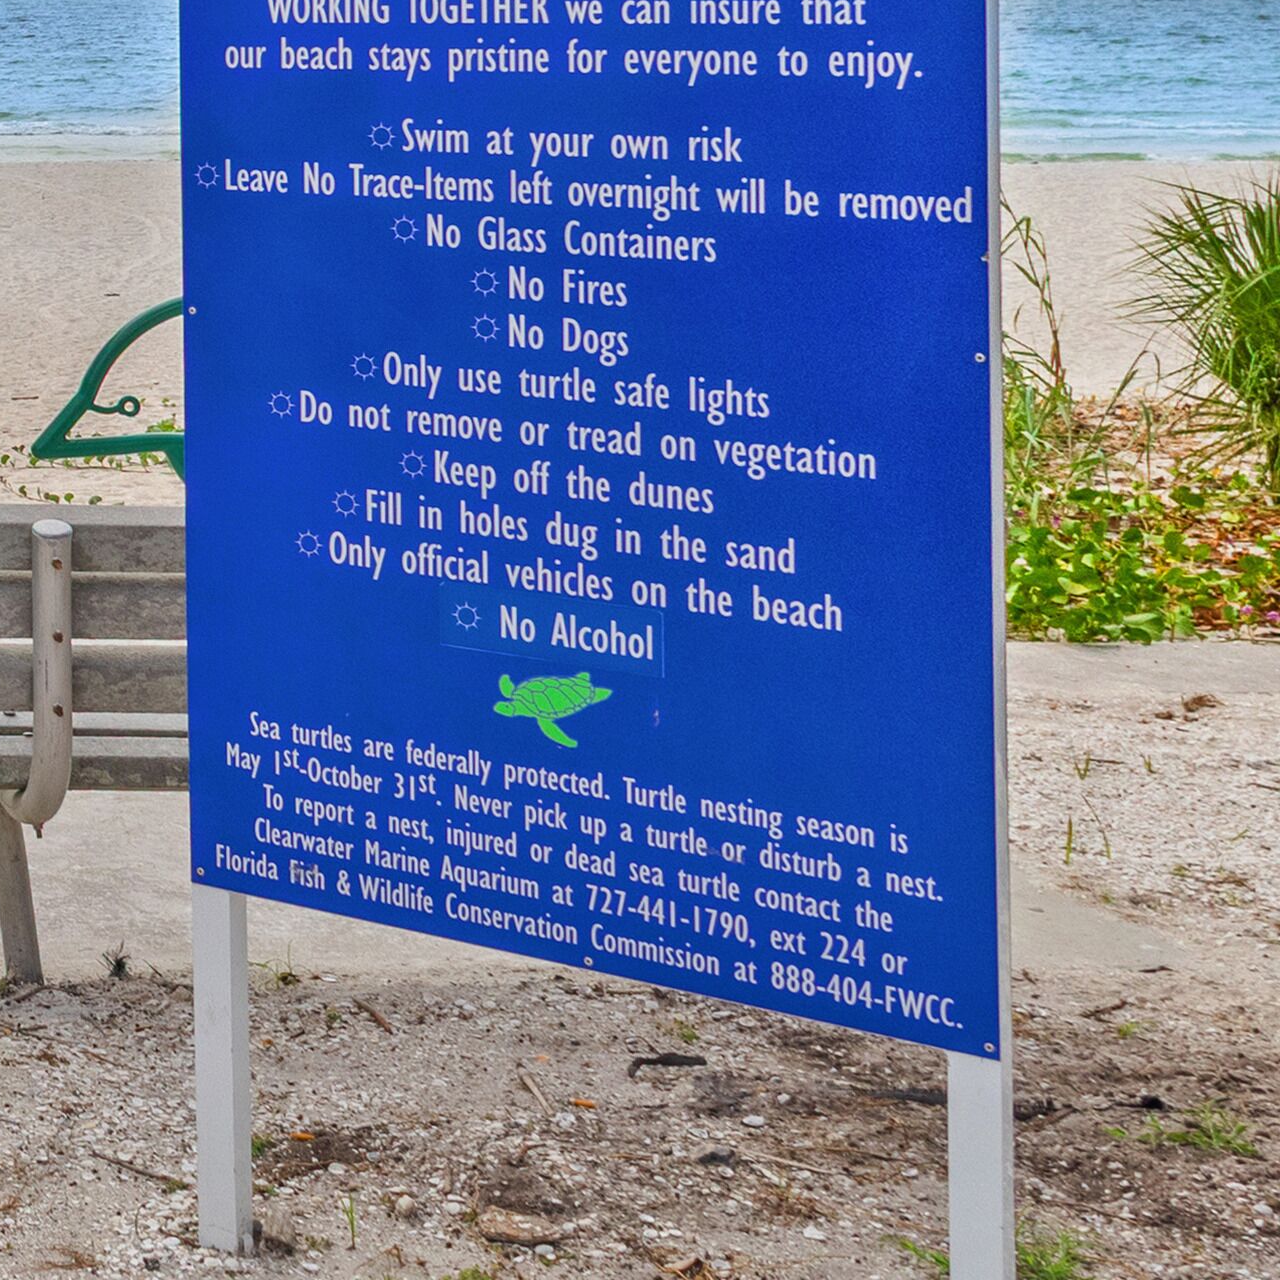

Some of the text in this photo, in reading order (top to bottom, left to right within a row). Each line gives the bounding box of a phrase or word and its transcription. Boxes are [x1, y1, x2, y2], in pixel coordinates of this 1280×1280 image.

[565, 0, 603, 25] we
[621, 0, 670, 25] can
[225, 36, 923, 90] our beach stays pristine for everyone to enjoy.
[401, 118, 743, 168] Swim at your own risk
[225, 158, 972, 223] Leave No Trace-Items left overnight will be removed
[426, 213, 717, 263] No Glass Containers
[508, 265, 628, 307] No Fires
[508, 313, 629, 367] No Dogs
[383, 351, 770, 426] Only use turtle safe lights
[300, 390, 876, 481] Do not remove or tread on vegetation
[434, 449, 714, 514] Keep off the dunes
[366, 488, 795, 574] Fill in holes dug in the sand
[329, 531, 842, 632] Only official vehicles on the beach
[500, 604, 653, 660] No Alcohol
[250, 711, 908, 854] Sea turtles are federally protected. Turtle nesting season is
[226, 741, 261, 779] May
[394, 772, 442, 806] 31st.
[454, 783, 513, 819] Never
[524, 799, 568, 831] pick
[580, 815, 607, 845] up
[620, 822, 633, 843] a
[646, 825, 707, 857] turtle
[721, 842, 746, 863] or
[759, 841, 842, 882] disturb
[856, 867, 871, 888] a
[886, 872, 943, 902] nest.
[263, 783, 893, 932] To report a nest, injured or dead sea turtle contact the
[254, 817, 908, 975] Clearwater Marine Aquarium at 727-441-1790, ext 224 or
[216, 843, 963, 1029] Florida Fish & Wildlife Conservation Commission at 888-404-FWCC.
